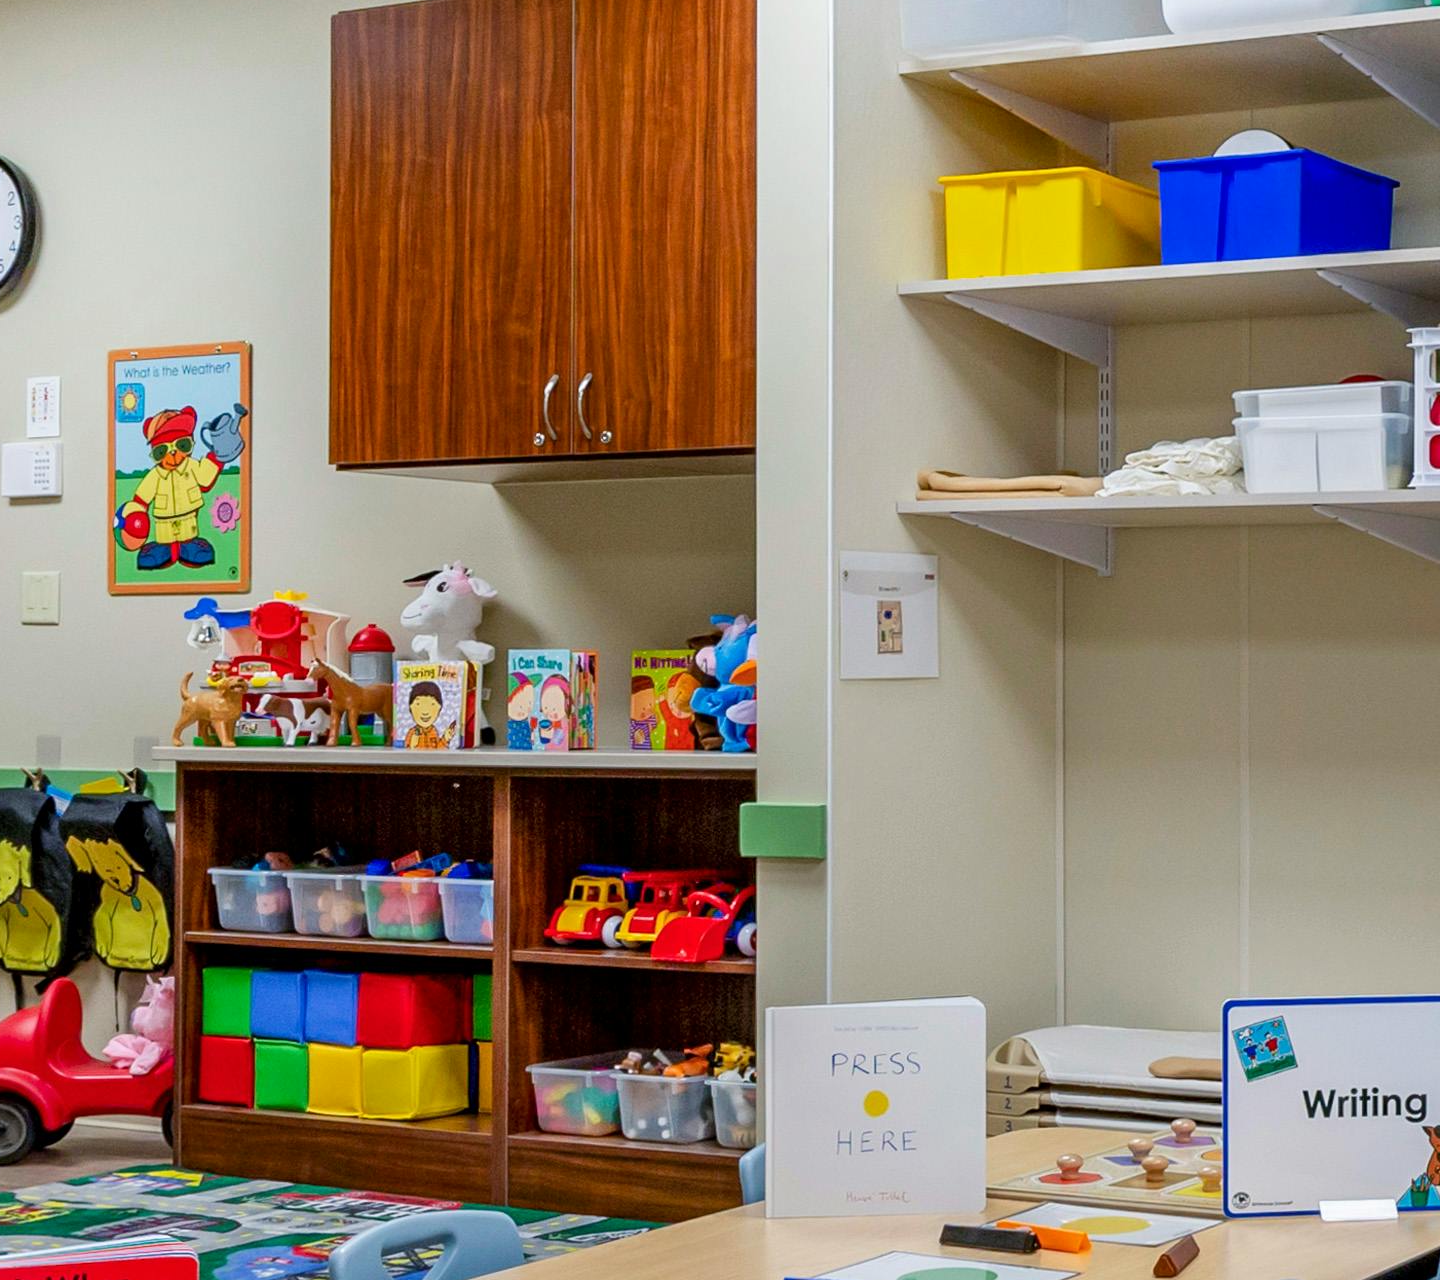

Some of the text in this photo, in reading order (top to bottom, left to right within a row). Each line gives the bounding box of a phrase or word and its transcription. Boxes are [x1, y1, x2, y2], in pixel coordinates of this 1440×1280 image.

[8, 191, 15, 206] 2
[14, 215, 22, 230] 3
[9, 240, 16, 252] 4
[124, 361, 231, 379] What is the Weather?
[518, 656, 534, 669] Can
[402, 665, 457, 680] Sharing Time
[831, 1051, 921, 1077] PRESS
[1004, 1075, 1012, 1089] 1
[1004, 1097, 1012, 1110] 2
[1302, 1087, 1427, 1122] Writing
[1005, 1120, 1012, 1132] 3
[836, 1130, 917, 1156] HERE
